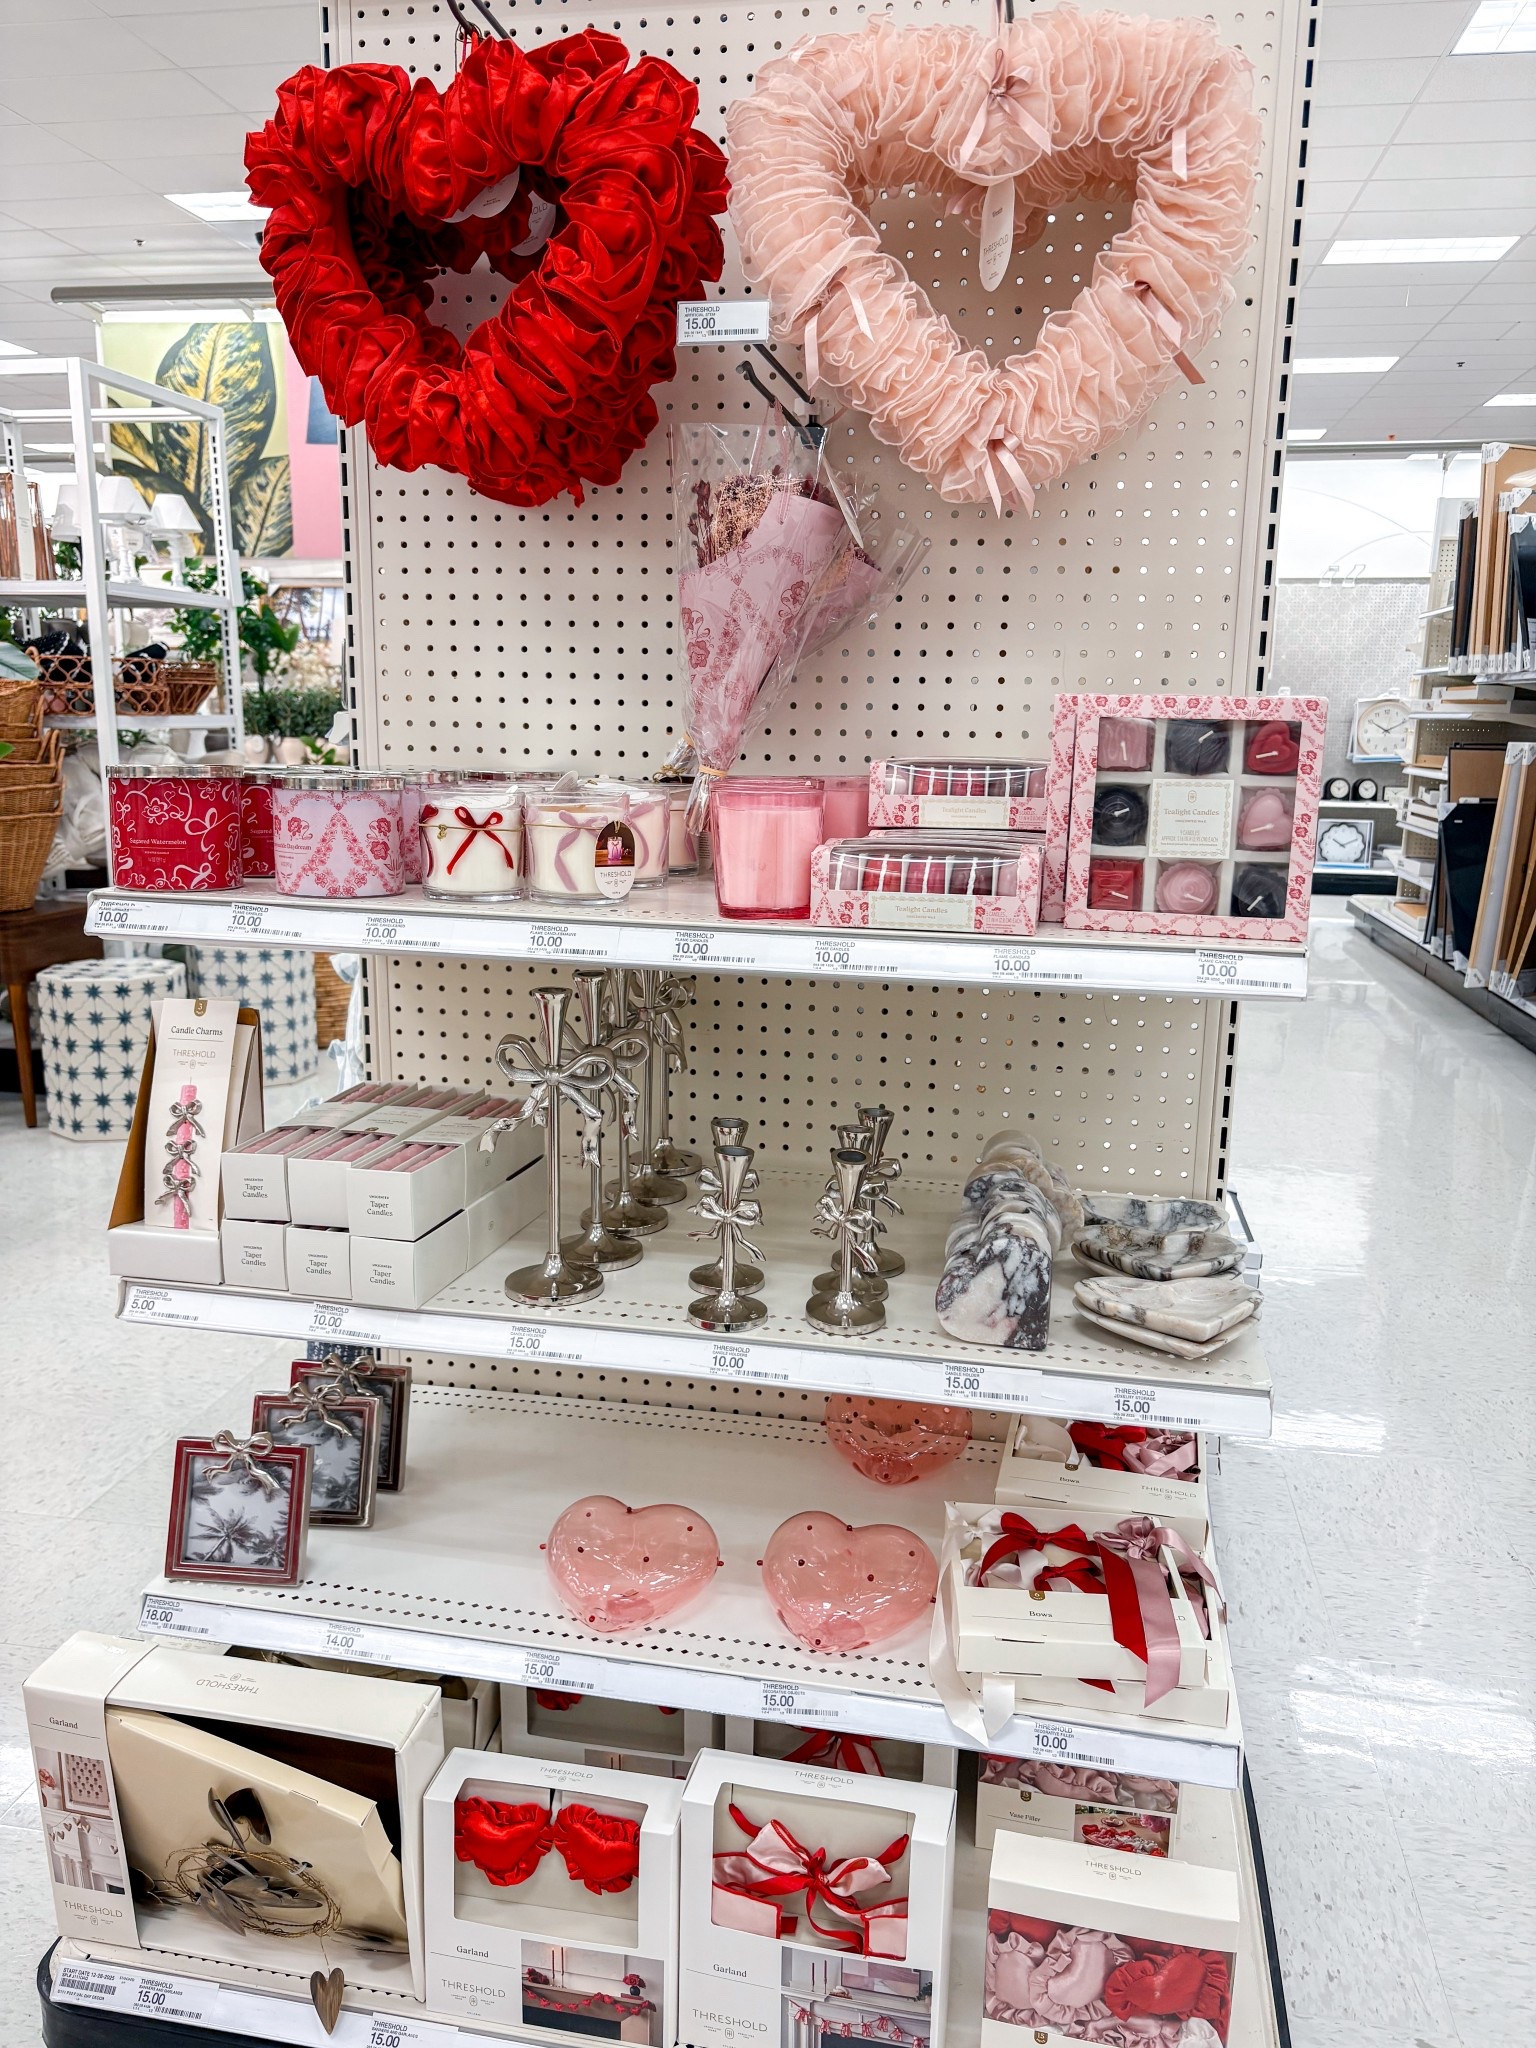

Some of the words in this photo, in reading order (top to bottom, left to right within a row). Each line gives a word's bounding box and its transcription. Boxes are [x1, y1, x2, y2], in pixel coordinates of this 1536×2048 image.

[983, 234, 1009, 257] THRESHOLD
[685, 317, 716, 330] 15.00
[1163, 808, 1191, 817] Tealight
[1192, 808, 1220, 816] Candles
[129, 837, 150, 845] Sugared
[600, 870, 632, 878] THRESHOLD
[234, 905, 269, 913] THRESHOLD
[895, 905, 921, 913] Tealight
[98, 911, 129, 923] 10.00
[231, 915, 262, 927] 10.00
[365, 927, 397, 939] 10.00
[530, 935, 563, 947] 10.00
[815, 940, 856, 948] THRESHOLD
[675, 942, 709, 955] 10.00
[994, 948, 1036, 956] THRESHOLD
[815, 951, 850, 963] 10.00
[1199, 952, 1244, 961] THRESHOLD
[993, 959, 1031, 972] 10.00
[1198, 963, 1237, 977] 10.00
[171, 1025, 195, 1034] Candle
[195, 1026, 223, 1036] Charms
[173, 1048, 216, 1058] THRESHOLD
[369, 1201, 388, 1210] Taper
[366, 1209, 393, 1217] Candles
[244, 1251, 262, 1259] Taper
[241, 1258, 267, 1267] Candles
[309, 1260, 327, 1268] Taper
[305, 1267, 332, 1275] Candles
[373, 1270, 392, 1278] Taper
[369, 1277, 396, 1286] Candles
[135, 1288, 168, 1297] THRESHOLD
[131, 1299, 155, 1311] 5.00
[315, 1303, 349, 1314] THRESHOLD
[313, 1314, 342, 1328] 10.00
[511, 1325, 547, 1334] THRESHOLD
[510, 1336, 541, 1350] 15.00
[713, 1344, 750, 1353] THRESHOLD
[712, 1355, 744, 1369] 10.00
[945, 1365, 985, 1374] THRESHOLD
[945, 1376, 980, 1391] 15.00
[1114, 1387, 1156, 1397] THRESHOLD
[1114, 1399, 1150, 1413] 15.00
[1059, 1476, 1080, 1484] Bows
[1141, 1485, 1197, 1498] THRESHOLD
[148, 1598, 181, 1608] THRESHOLD
[145, 1609, 173, 1622] 18.00
[1029, 1610, 1053, 1618] Bows
[328, 1623, 361, 1633] THRESHOLD
[325, 1633, 355, 1648] 14.00
[525, 1651, 560, 1661] THRESHOLD
[524, 1663, 554, 1676] 15.00
[196, 1678, 260, 1694] THRESHOLD
[763, 1683, 799, 1691] THRESHOLD
[763, 1694, 794, 1707] 15.00
[49, 1716, 78, 1729] Garland
[1035, 1722, 1073, 1734] THRESHOLD
[1034, 1734, 1068, 1750] 10.00
[539, 1766, 594, 1779] THRESHOLD
[794, 1770, 854, 1785] THRESHOLD
[1025, 1814, 1040, 1822] Filler
[1085, 1860, 1142, 1876] THRESHOLD
[63, 1900, 123, 1918] THRESHOLD
[456, 1944, 489, 1959] Garland
[78, 1969, 90, 1977] DATE
[713, 1962, 747, 1978] Garland
[141, 1979, 173, 1989] THRESHOLD
[441, 1978, 506, 1998] THRESHOLD
[138, 1990, 166, 2006] 15.00
[374, 2020, 408, 2031] THRESHOLD
[692, 2008, 768, 2032] THRESHOLD
[371, 2031, 400, 2048] 15.00
